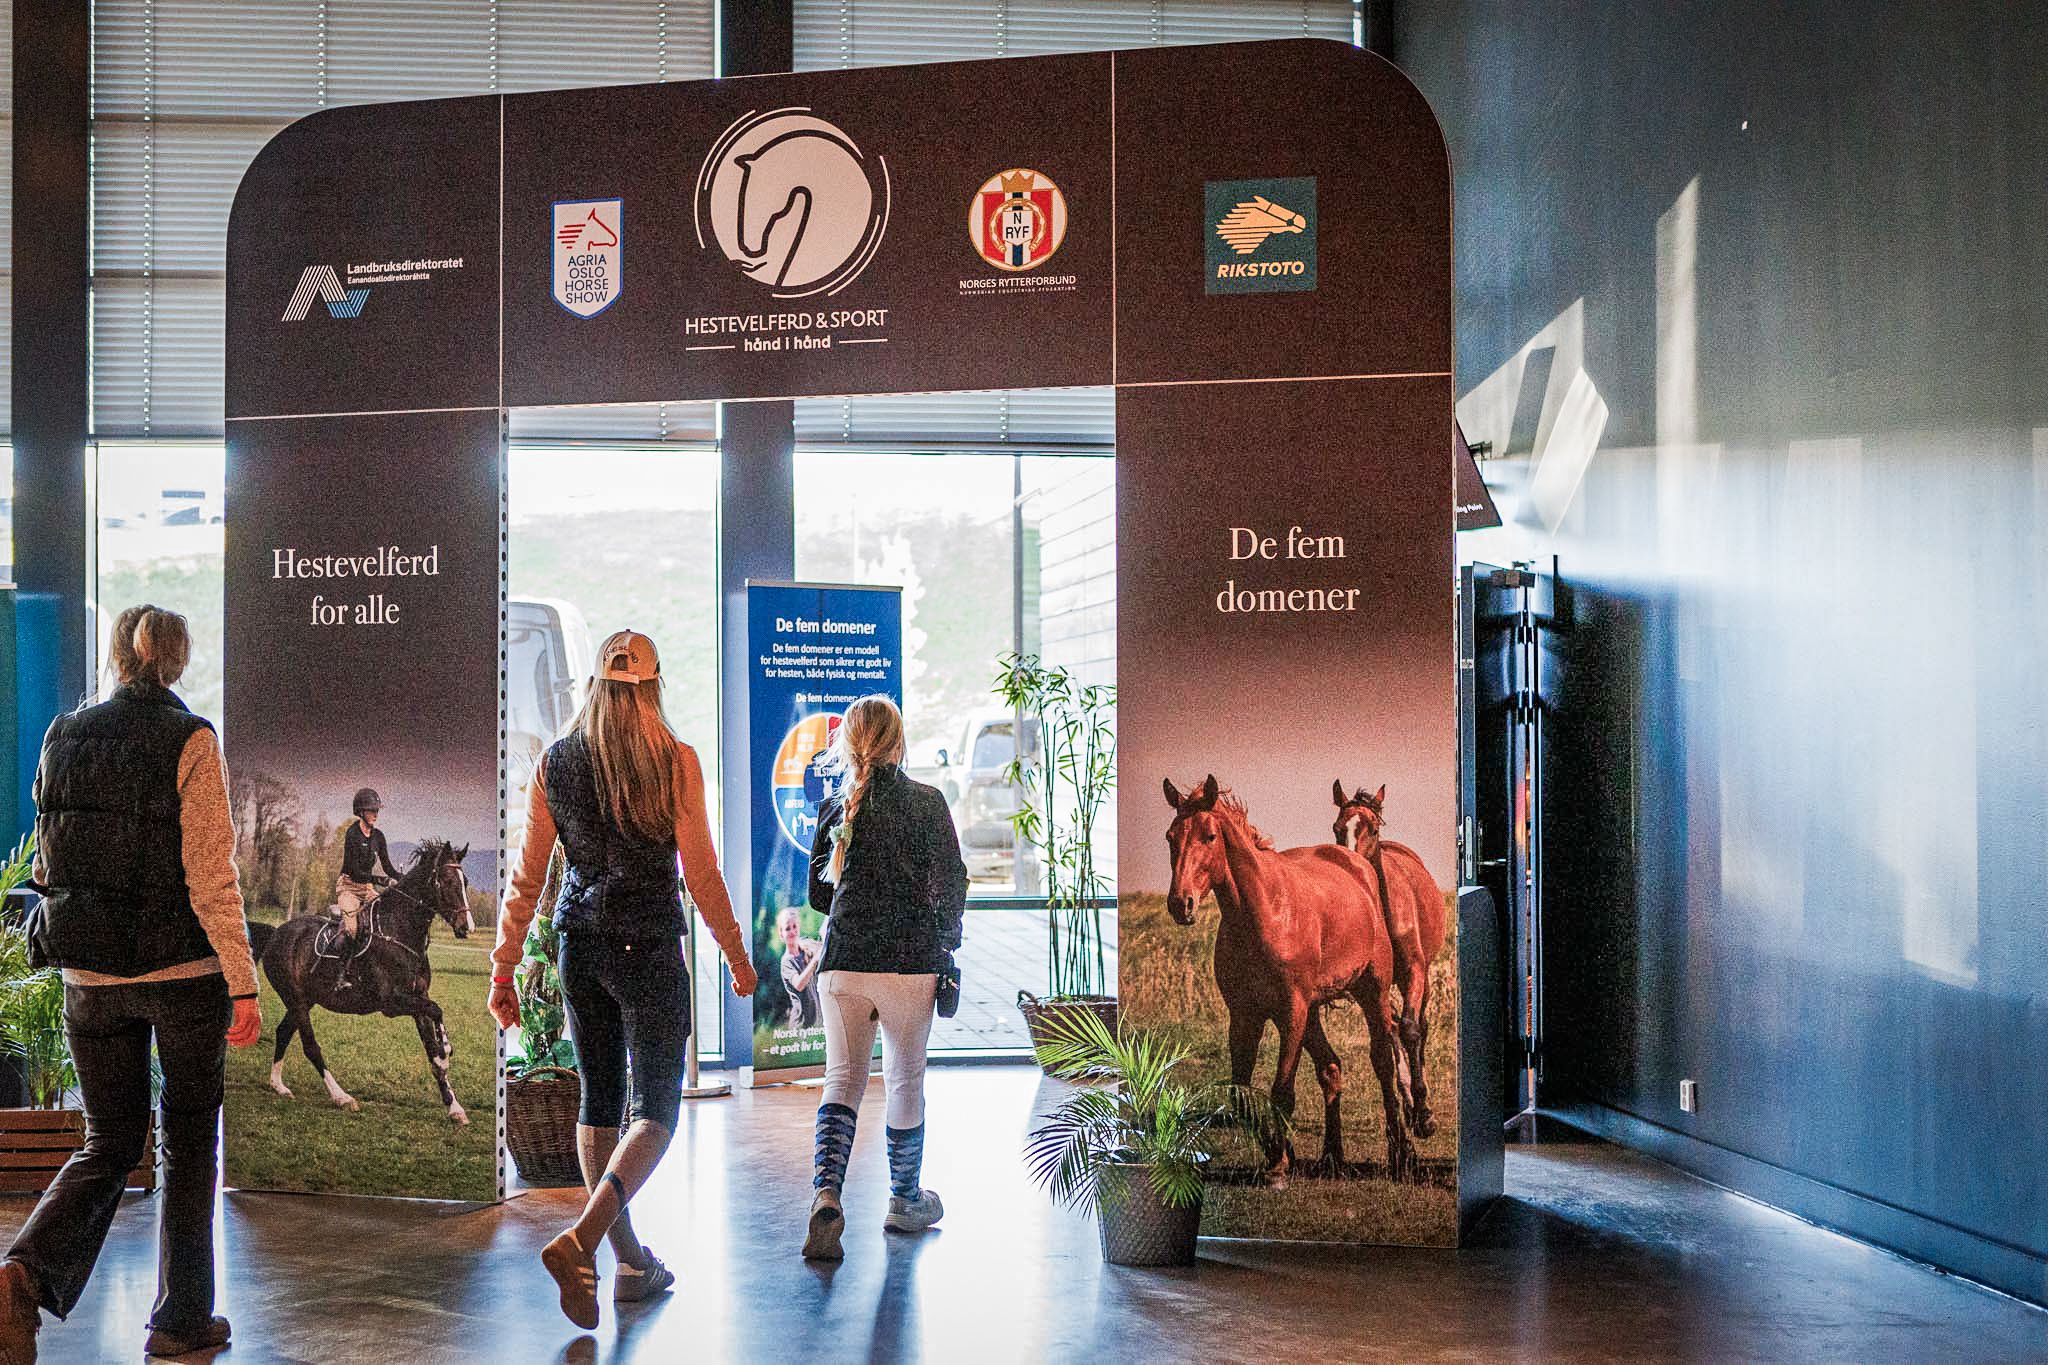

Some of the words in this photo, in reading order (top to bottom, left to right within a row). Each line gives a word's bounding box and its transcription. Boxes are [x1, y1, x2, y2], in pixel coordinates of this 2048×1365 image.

[1013, 212, 1022, 225] N
[1005, 225, 1030, 239] RYF
[347, 257, 464, 274] Landbruksdirektoratet
[567, 254, 607, 267] AGRIA
[569, 266, 605, 279] OSLO
[1217, 261, 1305, 278] RIKSTOTO
[565, 279, 608, 292] HORSE
[960, 279, 997, 289] NORGES
[998, 275, 1076, 287] RYTTERFORBUND
[565, 291, 608, 304] SHOW
[685, 313, 813, 334] HESTEVELFERD
[815, 313, 829, 329] &
[830, 309, 889, 328] SPORT
[744, 337, 781, 351] hånd
[785, 337, 790, 349] i
[794, 335, 831, 349] hånd
[1229, 527, 1278, 560] De
[1285, 526, 1347, 559] fem
[272, 544, 440, 579] Hestevelferd
[1216, 579, 1361, 613] domener
[310, 595, 348, 625] for
[354, 594, 400, 625] alle
[776, 617, 794, 633] De
[795, 617, 819, 633] fem
[822, 618, 877, 635] domener
[773, 643, 784, 653] De
[785, 643, 800, 654] fem
[801, 643, 834, 654] domener
[835, 646, 843, 655] er
[844, 646, 854, 655] en
[855, 645, 880, 655] modell
[760, 655, 771, 665] for
[773, 656, 818, 666] hestevelferd
[819, 658, 835, 667] som
[836, 657, 856, 667] sikrer
[857, 658, 865, 667] et
[866, 658, 883, 669] godt
[883, 657, 892, 668] liv
[765, 668, 777, 678] for
[778, 668, 805, 679] hesten,
[806, 669, 825, 679] både
[826, 669, 845, 680] fysisk
[846, 671, 856, 681] og
[857, 669, 887, 680] mentalt.
[795, 692, 807, 703] De
[807, 692, 822, 703] fem
[773, 1028, 798, 1039] Norsk
[770, 1044, 780, 1055] et
[780, 1042, 800, 1055] godt
[801, 1040, 811, 1051] liv
[812, 1039, 826, 1051] for
